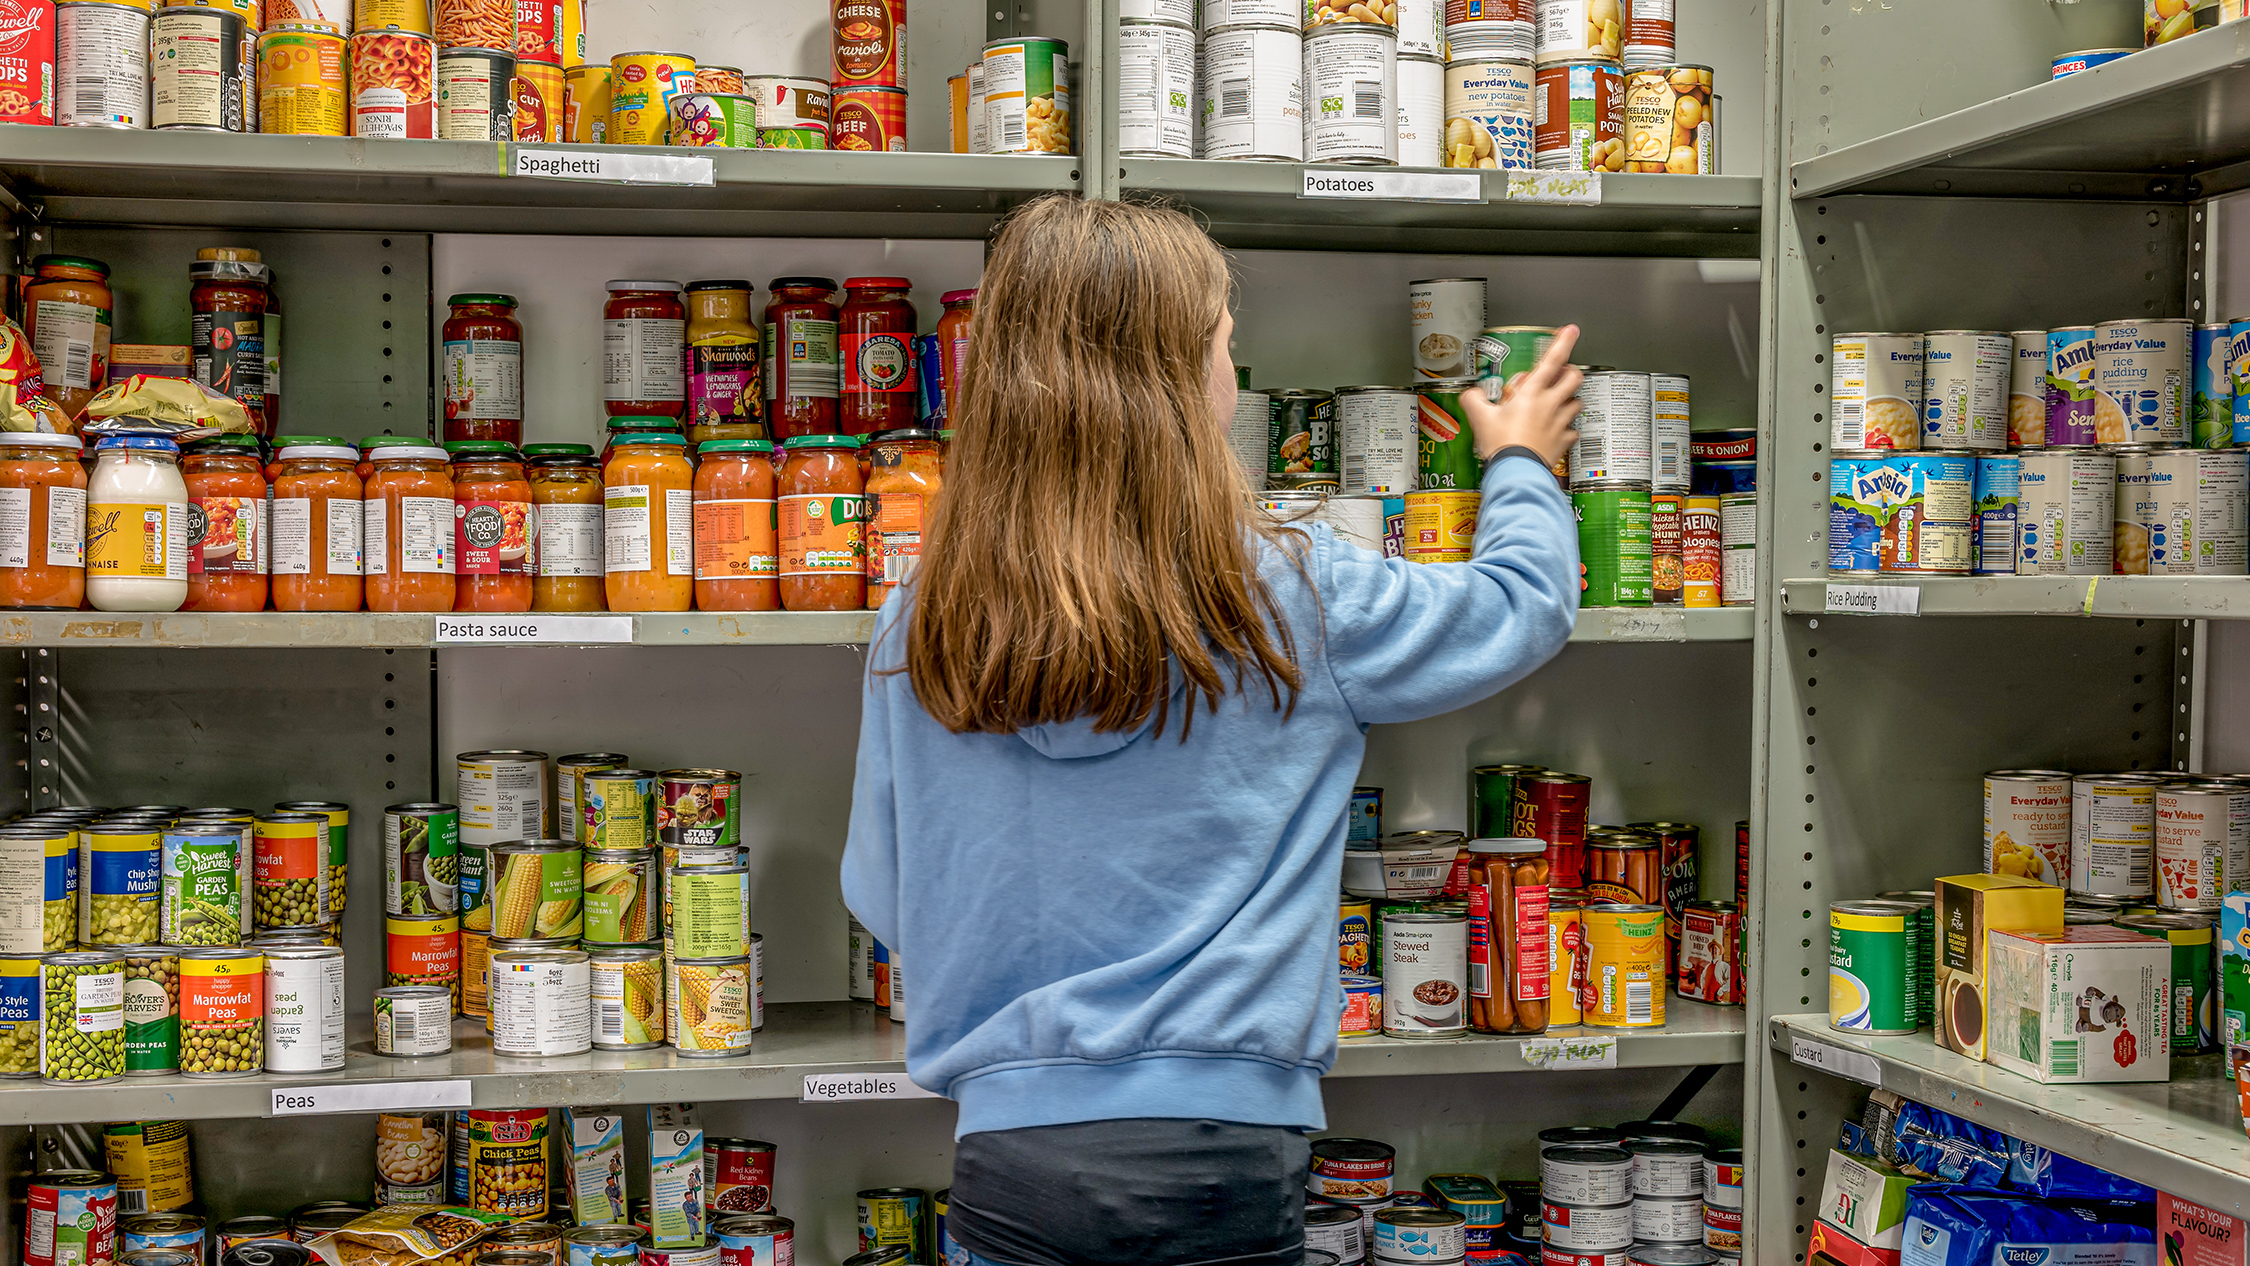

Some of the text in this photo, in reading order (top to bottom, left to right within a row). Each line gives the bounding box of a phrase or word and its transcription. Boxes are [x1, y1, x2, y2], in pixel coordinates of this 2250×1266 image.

[837, 5, 881, 20] CHEESE
[837, 39, 884, 56] ravioli
[845, 61, 872, 69] tomato
[2053, 61, 2086, 76] PRINCES
[657, 65, 671, 78] new!
[1486, 67, 1512, 75] TESCO
[1463, 79, 1529, 90] Everyday Value
[520, 95, 540, 108] CUT
[1468, 91, 1526, 103] new potatoes
[1635, 96, 1661, 104] TESCO
[840, 109, 862, 117] TESCO
[1626, 107, 1672, 117] PEELED NEW
[1628, 116, 1665, 125] POTATOES
[358, 124, 404, 134] SPAGHETTI
[836, 121, 868, 136] BEEF
[519, 155, 600, 174] Spaghetti
[1306, 176, 1374, 192] Potatoes
[2110, 328, 2138, 338] TESCO
[864, 337, 901, 349] BARESA
[2095, 339, 2166, 352] Everyday Value
[1927, 351, 1952, 361] Value
[2112, 356, 2134, 367] rice
[2102, 366, 2148, 380] pudding
[705, 374, 738, 383] VIETNAMESE
[706, 382, 741, 391] LEMONGRASS
[712, 391, 732, 399] GINGER
[1706, 443, 1749, 456] & ONION
[2022, 473, 2046, 483] Value
[2150, 473, 2173, 483] Value
[1412, 496, 1426, 504] COOK
[1656, 503, 1675, 512] ASDA
[471, 516, 495, 524] HEARTY
[1983, 511, 1999, 520] 400g
[469, 521, 497, 533] FOOD
[1683, 514, 1718, 532] HEINZ
[9, 556, 24, 566] 440g
[292, 562, 306, 572] 440g
[1697, 590, 1707, 598] 57
[1827, 593, 1877, 611] Rice Pudding
[438, 621, 538, 639] Pasta sauce
[2037, 785, 2063, 794] TESCO
[497, 793, 513, 803] 325g
[2011, 796, 2052, 808] Everyday
[497, 804, 513, 814] 260g
[2012, 812, 2051, 824] ready to
[2174, 811, 2204, 821] Value
[256, 826, 265, 836] 45p
[2030, 820, 2066, 832] custard
[686, 829, 713, 838] STAR
[2163, 827, 2201, 837] to serve
[683, 836, 717, 845] WARS
[200, 851, 226, 863] Sweet
[190, 857, 231, 875] Harvest
[127, 870, 144, 881] Chip
[196, 876, 227, 885] GARDEN
[126, 881, 157, 895] Mushy
[195, 884, 228, 896] PEAS
[563, 886, 579, 894] WATER
[432, 923, 445, 934] 45p
[1628, 928, 1652, 937] HEINZ
[1689, 934, 1710, 944] CORNED
[691, 943, 732, 953] 200g 165g
[1393, 941, 1429, 952] Stewed
[1693, 943, 1704, 951] BEEF
[411, 949, 458, 963] Marrowfat
[1393, 952, 1419, 964] Steak
[214, 963, 231, 976] 45p
[426, 961, 449, 973] Peas
[1631, 964, 1645, 972] 400g
[94, 977, 115, 986] TESCO
[210, 982, 233, 991] shopper
[213, 977, 231, 986] happy
[723, 986, 742, 994] TESCO
[5, 995, 29, 1008] Style
[80, 992, 108, 1001] GARDEN
[192, 993, 252, 1006] Marrowfat
[275, 993, 298, 1003] peas
[720, 1000, 741, 1009] SWEET
[1, 1006, 29, 1019] Peas
[208, 1006, 237, 1020] Peas
[270, 1006, 304, 1017] garden
[710, 1006, 746, 1016] SWEETCORN
[1393, 1018, 1406, 1028] 392g
[272, 1027, 301, 1036] savers
[1793, 1042, 1823, 1063] Custard
[806, 1078, 896, 1098] Vegetables
[276, 1093, 315, 1109] Peas
[383, 1117, 414, 1131] Cannellini
[497, 1124, 526, 1133] SEA
[387, 1129, 409, 1140] Beans
[497, 1131, 528, 1140] ISLE
[483, 1147, 539, 1159] Chick Peas
[1323, 1160, 1338, 1168] TUNA
[1339, 1161, 1363, 1170] FLAKES
[1370, 1161, 1385, 1170] BRINE
[730, 1166, 764, 1176] Red Kidney
[739, 1173, 757, 1182] Beans
[1707, 1209, 1741, 1222] TUNA FLAKES
[1838, 1193, 1858, 1229] PG
[2171, 1199, 2232, 1228] WHAT'S YOUR
[2171, 1211, 2231, 1243] FLAVOUR?
[1922, 1226, 1936, 1242] Tetley
[2006, 1249, 2044, 1263] Tetley
